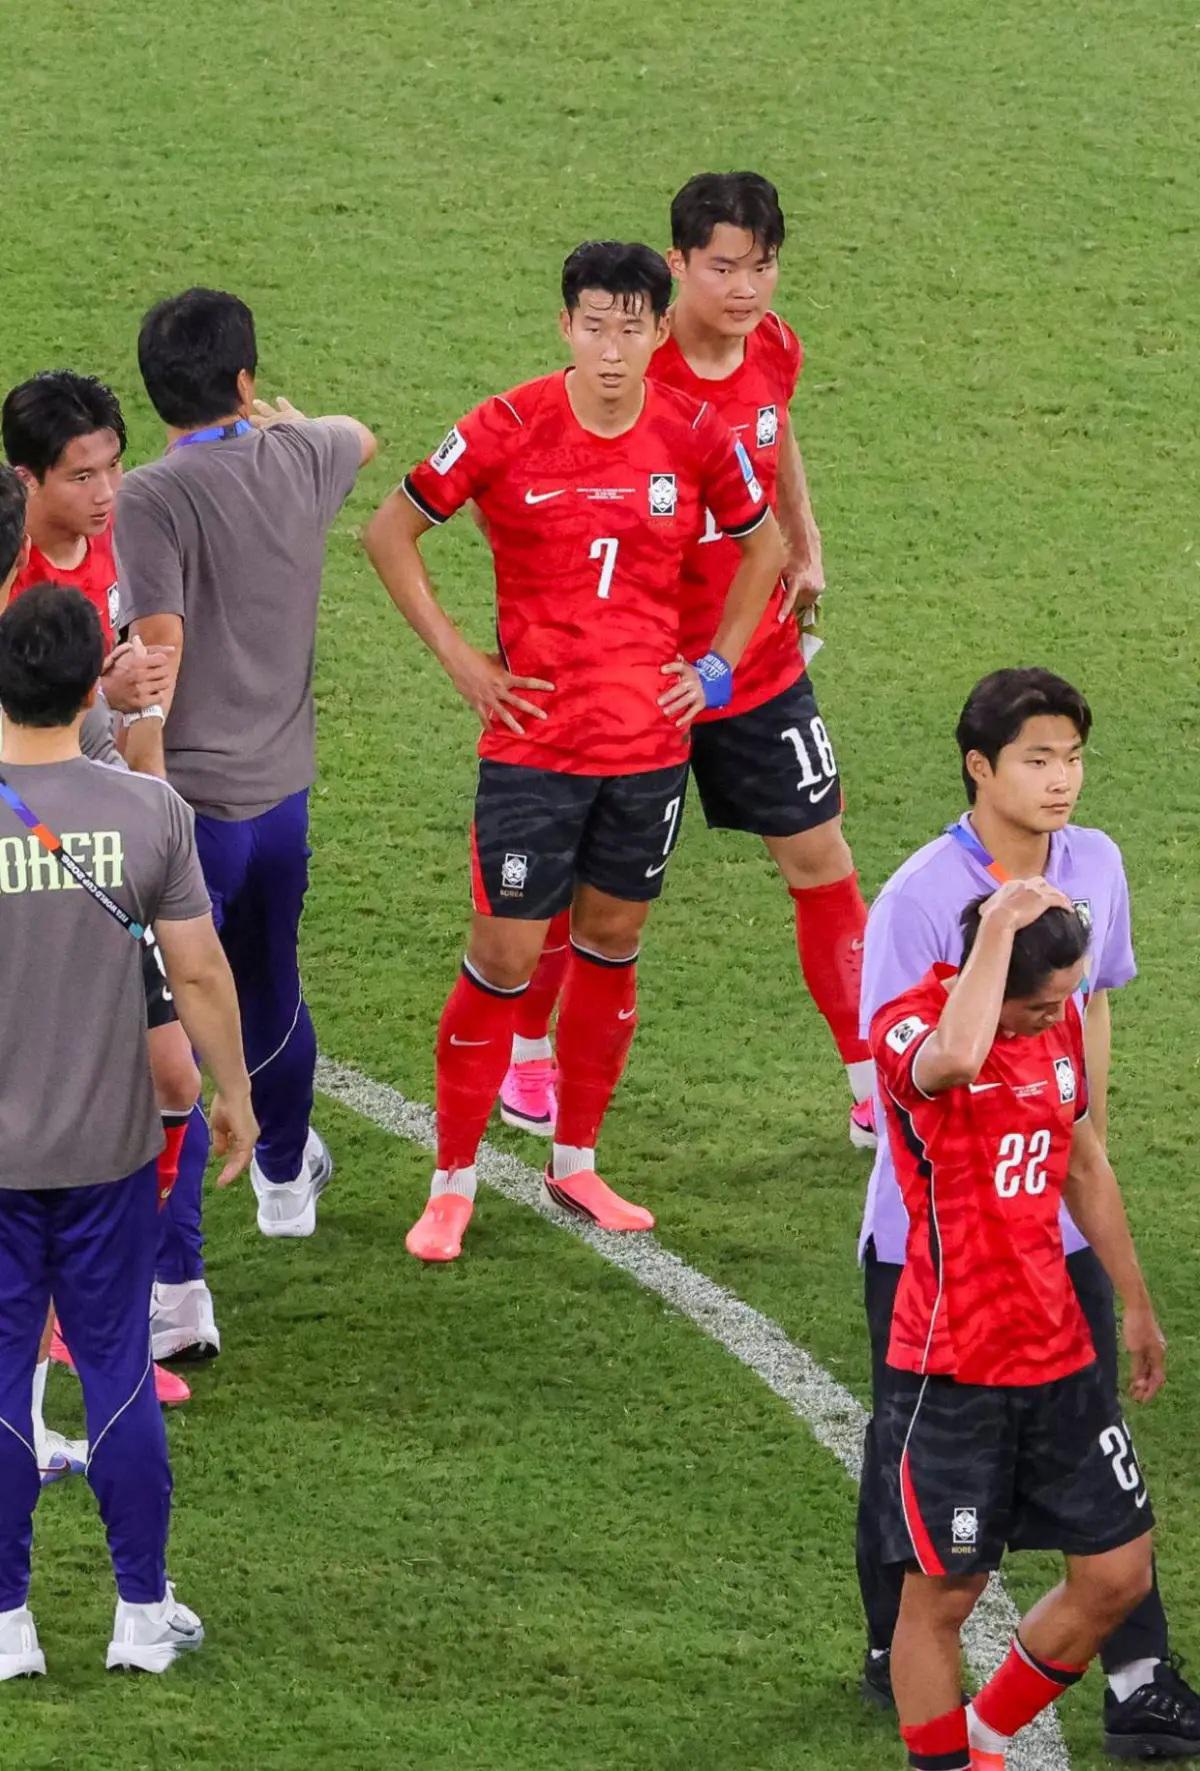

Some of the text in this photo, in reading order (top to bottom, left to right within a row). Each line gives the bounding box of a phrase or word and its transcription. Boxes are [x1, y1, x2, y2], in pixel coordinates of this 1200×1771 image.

[588, 537, 620, 600] 7
[781, 716, 837, 792] 18
[662, 796, 681, 856] 7
[0, 831, 124, 895] OREA
[61, 853, 86, 880] 2026
[82, 878, 98, 893] CUP
[95, 890, 118, 914] WORLD
[994, 1129, 1051, 1198] 22
[1099, 1418, 1140, 1491] 2
